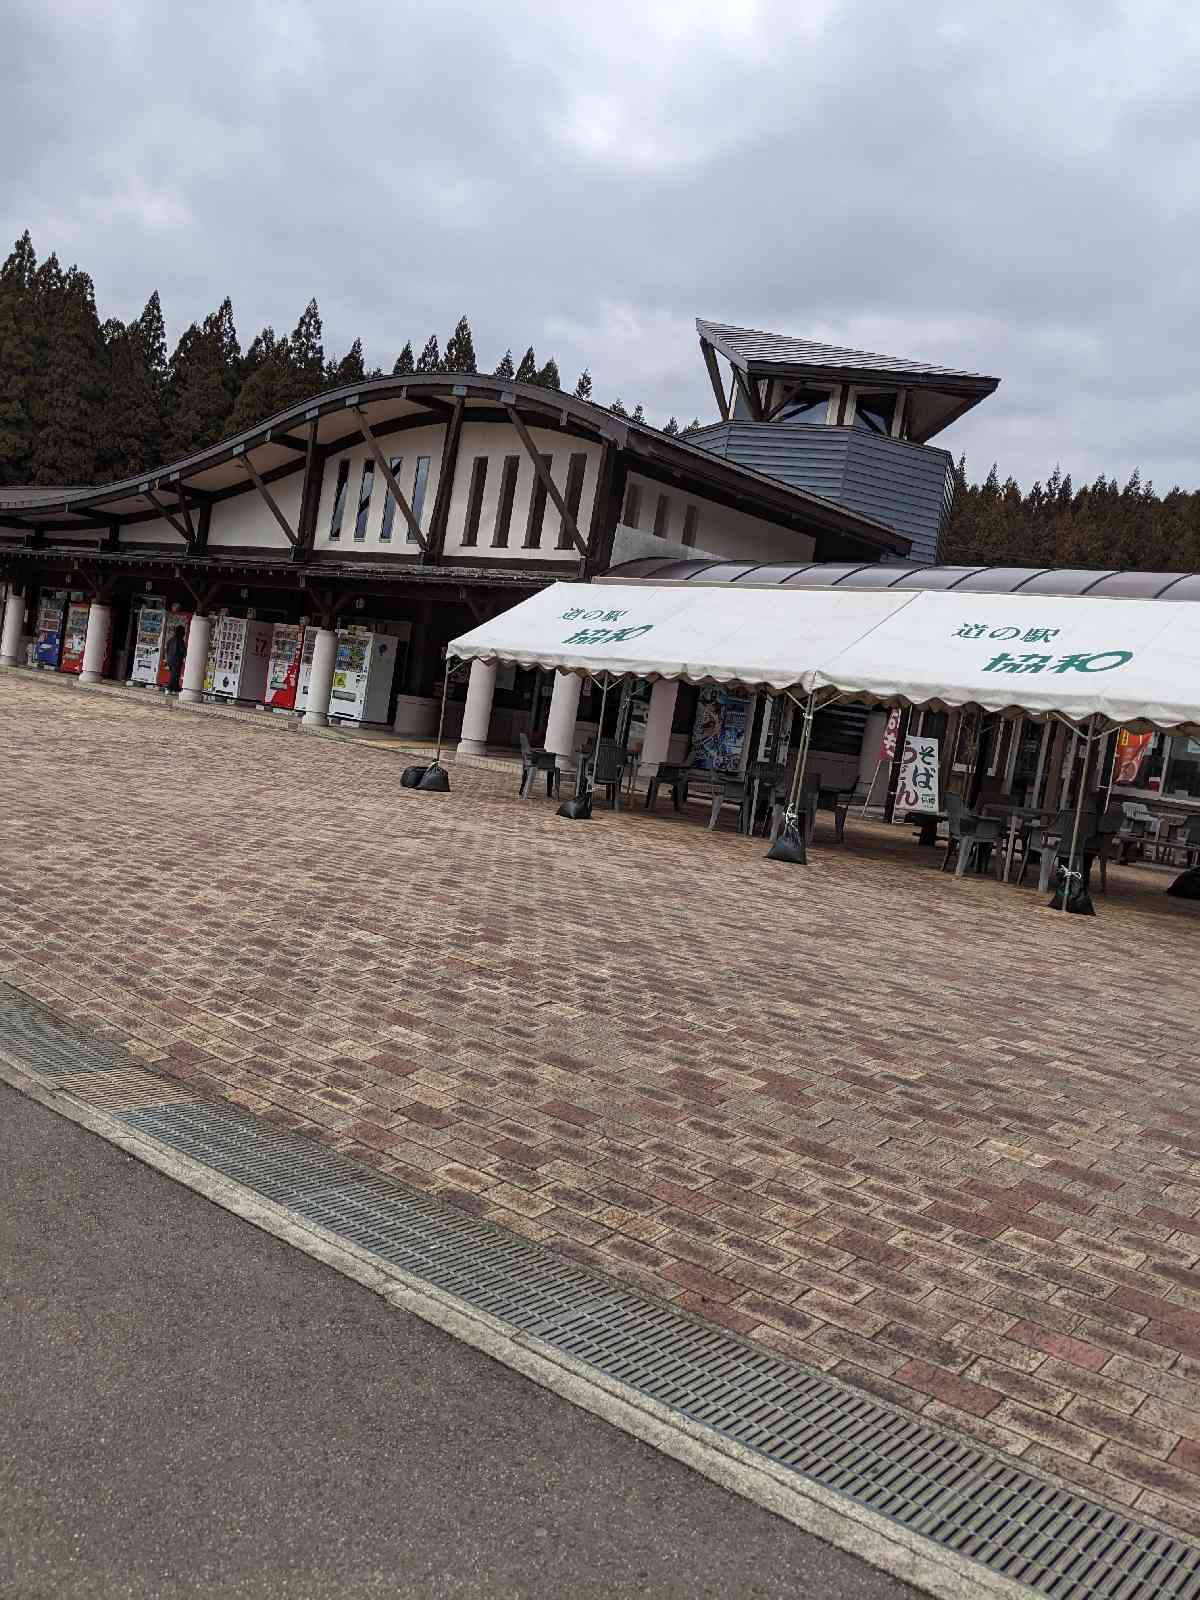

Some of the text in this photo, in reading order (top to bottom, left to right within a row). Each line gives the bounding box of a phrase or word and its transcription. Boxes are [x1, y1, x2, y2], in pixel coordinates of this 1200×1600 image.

[559, 607, 629, 622] 道の駅
[562, 624, 653, 645] 協和
[952, 622, 1061, 643] 道の駅
[982, 651, 1134, 675] 協和
[912, 744, 936, 791] そば
